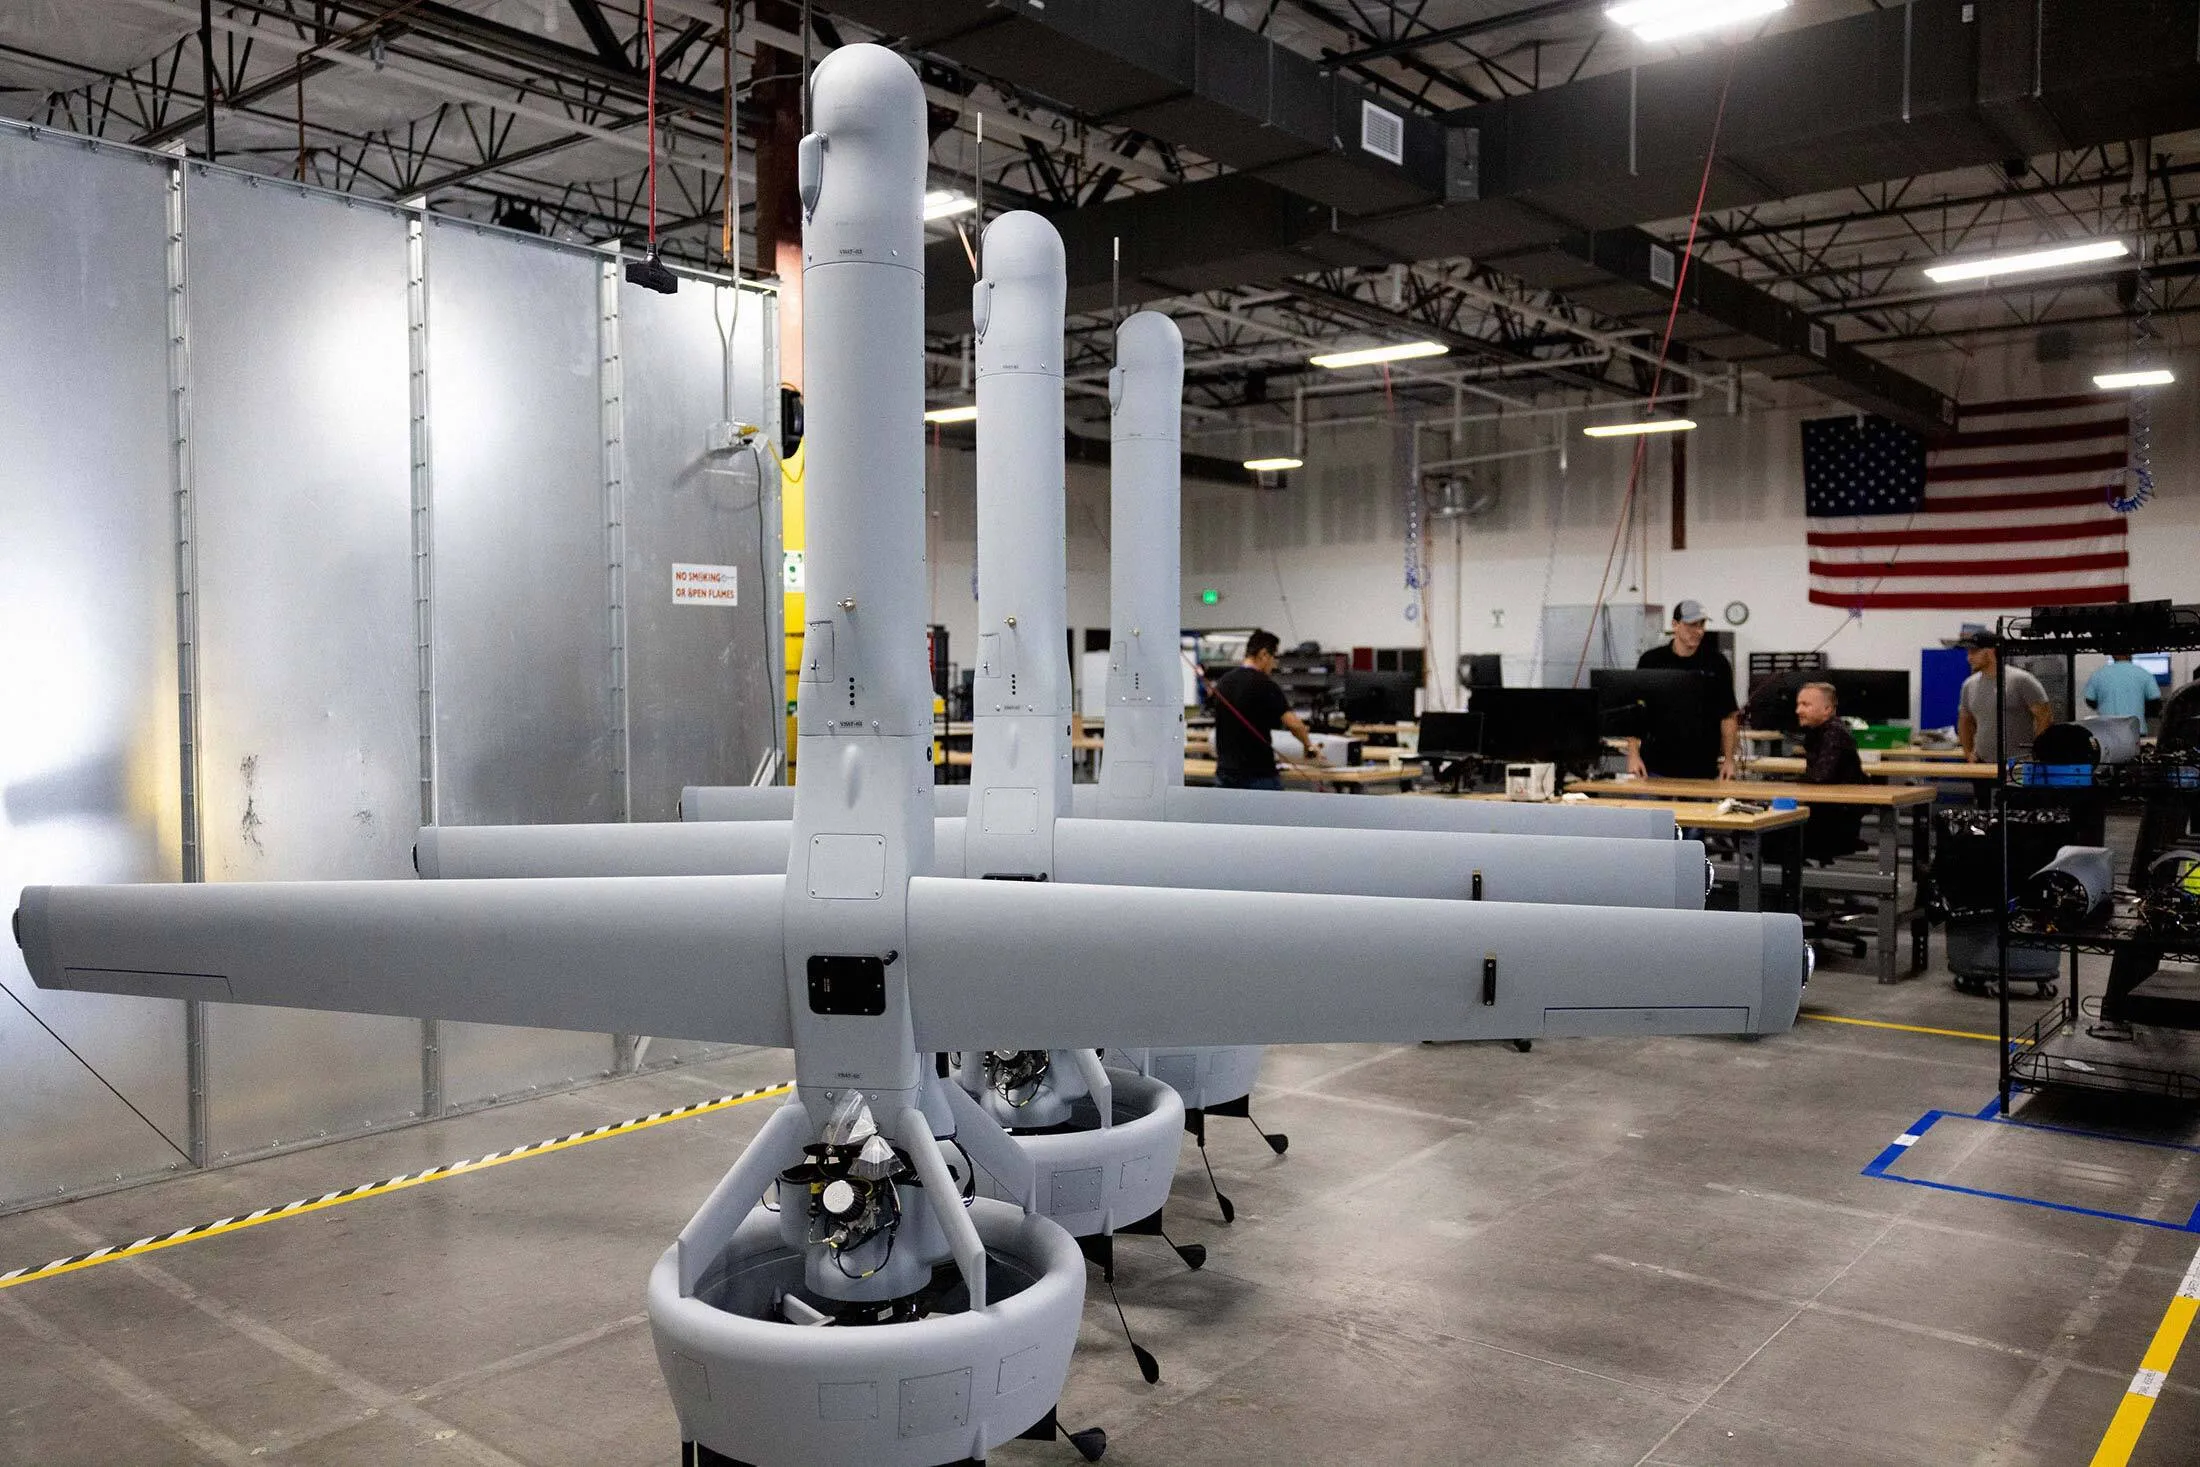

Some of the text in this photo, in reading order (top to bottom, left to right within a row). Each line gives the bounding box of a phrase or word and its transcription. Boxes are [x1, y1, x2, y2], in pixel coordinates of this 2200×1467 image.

[675, 571, 720, 582] NO SMOKING
[675, 587, 734, 599] OR OPEN FLAMES
